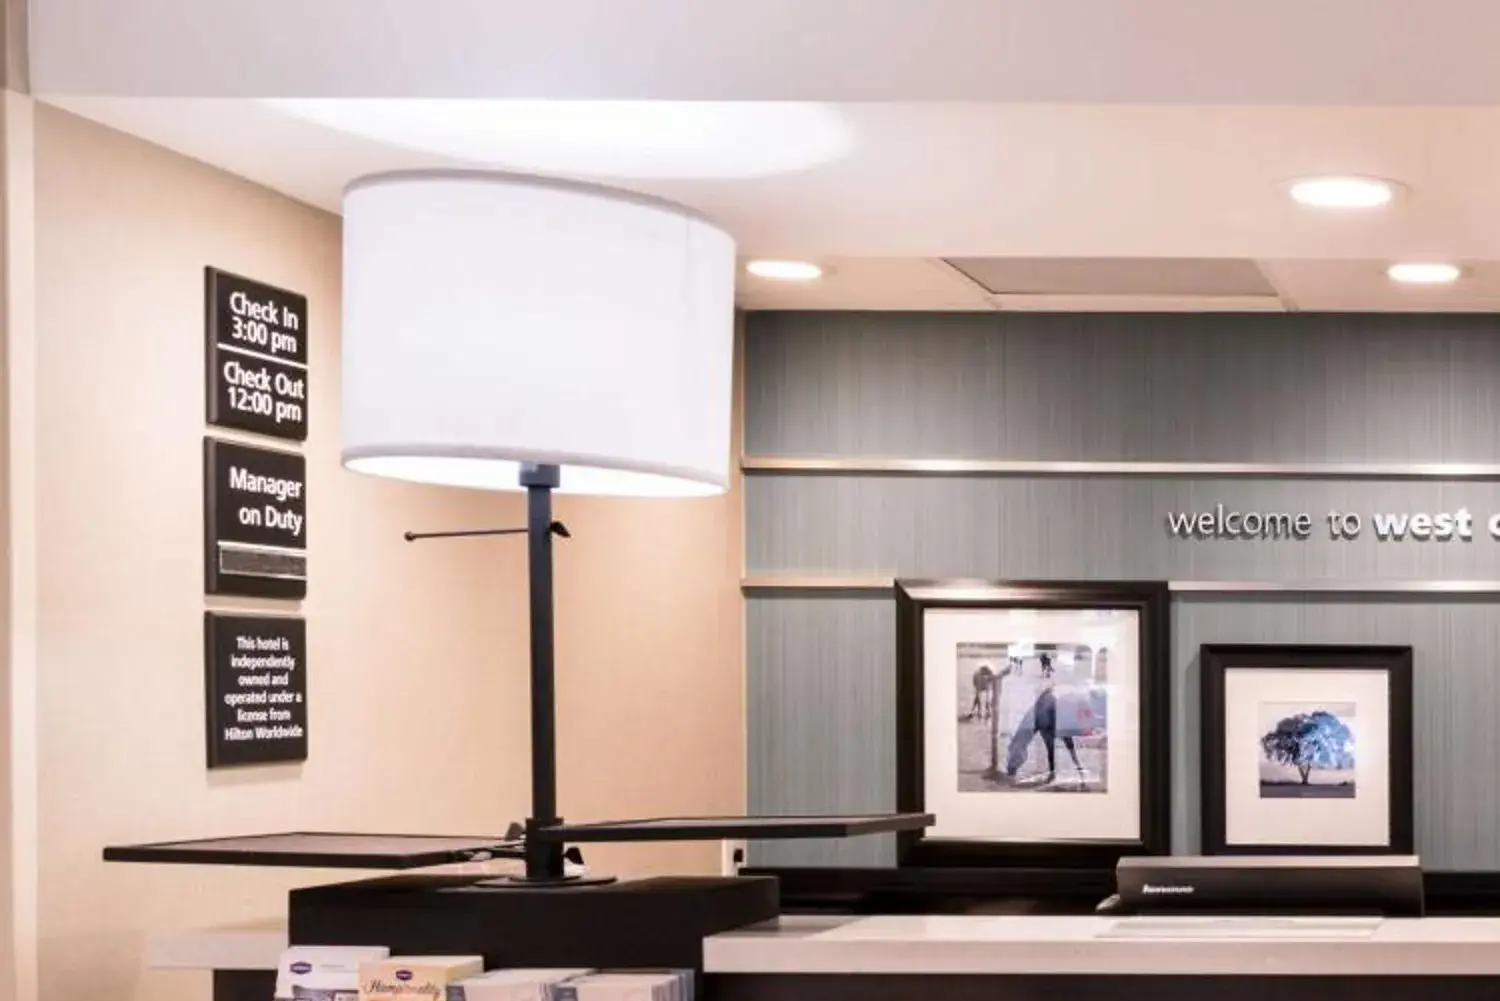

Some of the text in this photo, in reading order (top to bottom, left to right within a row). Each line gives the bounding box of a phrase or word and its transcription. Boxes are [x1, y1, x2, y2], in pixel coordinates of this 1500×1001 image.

[229, 291, 299, 331] Check In
[231, 316, 297, 354] 3:00 pm
[223, 361, 305, 399] Check Out
[227, 386, 302, 423] 12:00 pm
[229, 465, 303, 502] Manager
[238, 504, 303, 536] on Duty
[1167, 503, 1312, 536] welcome
[1326, 508, 1362, 536] to
[1372, 507, 1473, 537] west
[236, 636, 289, 650] This hotel is
[231, 654, 295, 671] independently
[238, 672, 289, 686] owned and
[224, 690, 303, 707] operated under a
[237, 706, 291, 722] license from
[224, 725, 304, 741] Hilton Worldwide
